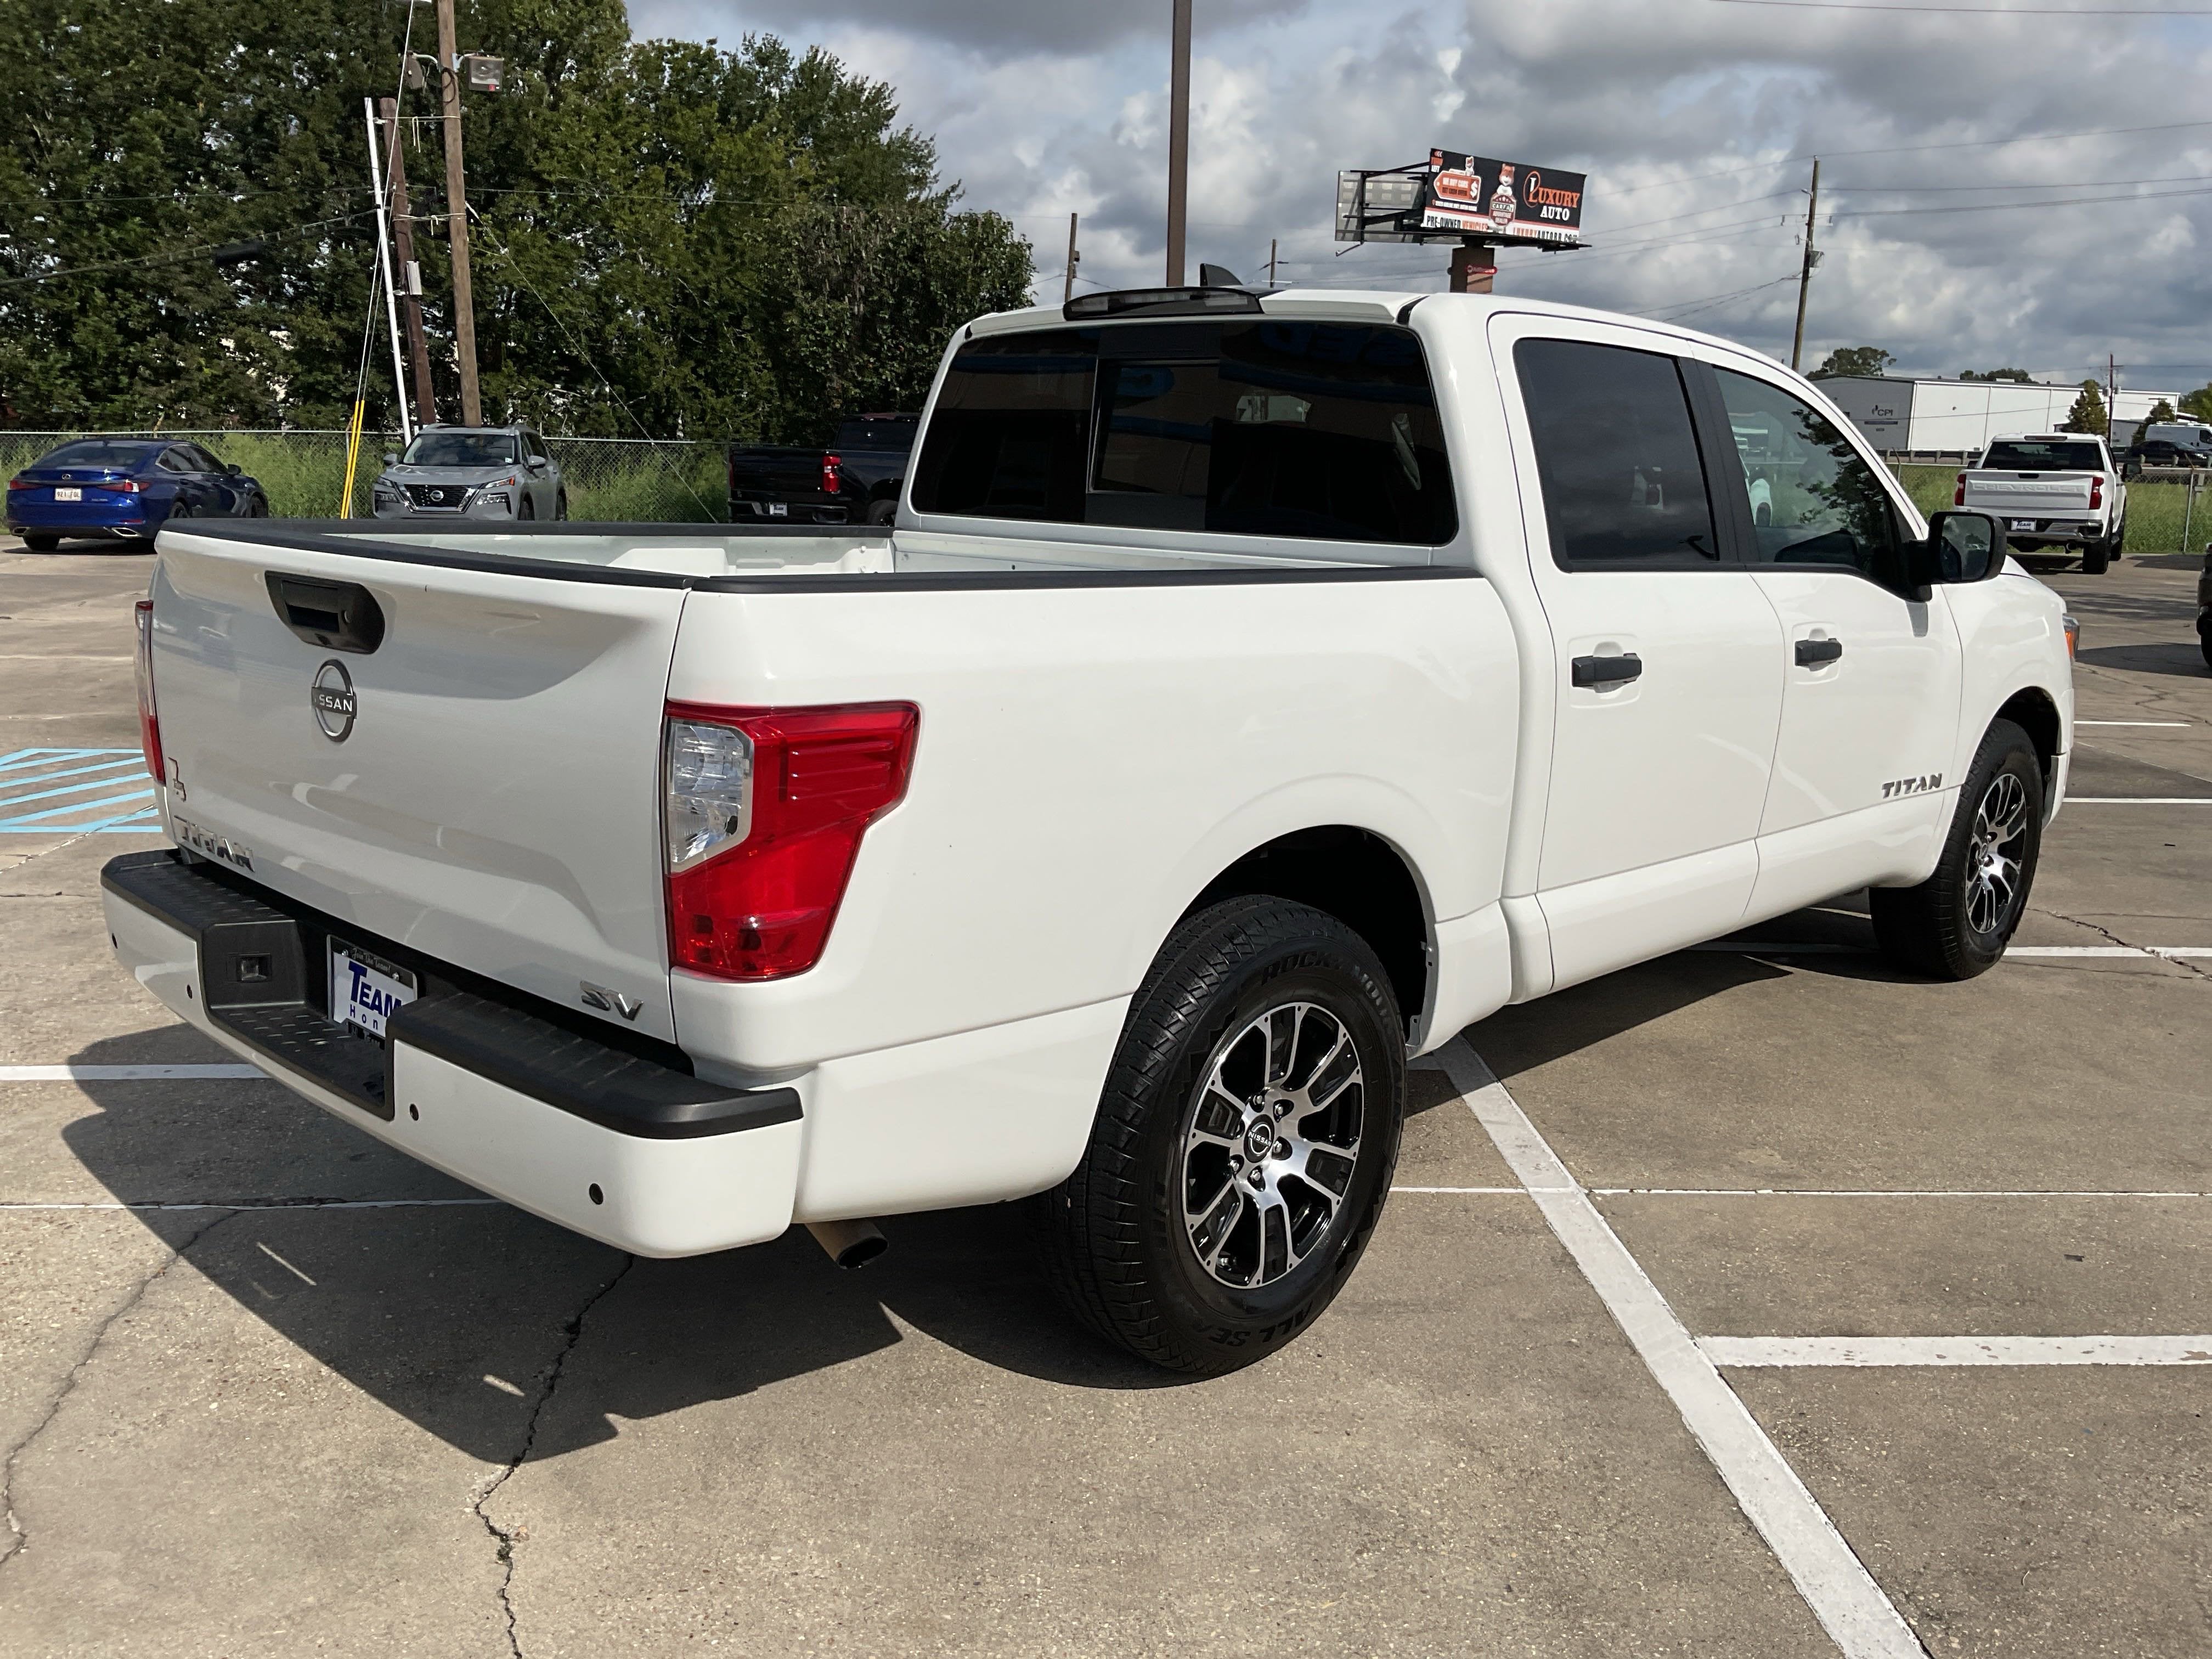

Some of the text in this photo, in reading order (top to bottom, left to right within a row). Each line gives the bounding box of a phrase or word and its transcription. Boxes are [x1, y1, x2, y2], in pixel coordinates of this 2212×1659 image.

[1523, 172, 1580, 208] LUXURY
[1426, 216, 1461, 229] PRE-OWNED
[1540, 206, 1570, 221] AUTO
[1973, 483, 2080, 493] CHEVROLET
[312, 693, 353, 712] SSAN
[1882, 772, 1943, 799] TITAN
[348, 961, 402, 1018] TEAM
[580, 980, 644, 1021] SV
[349, 1004, 379, 1030] Hon
[1248, 1131, 1272, 1147] NISSAN
